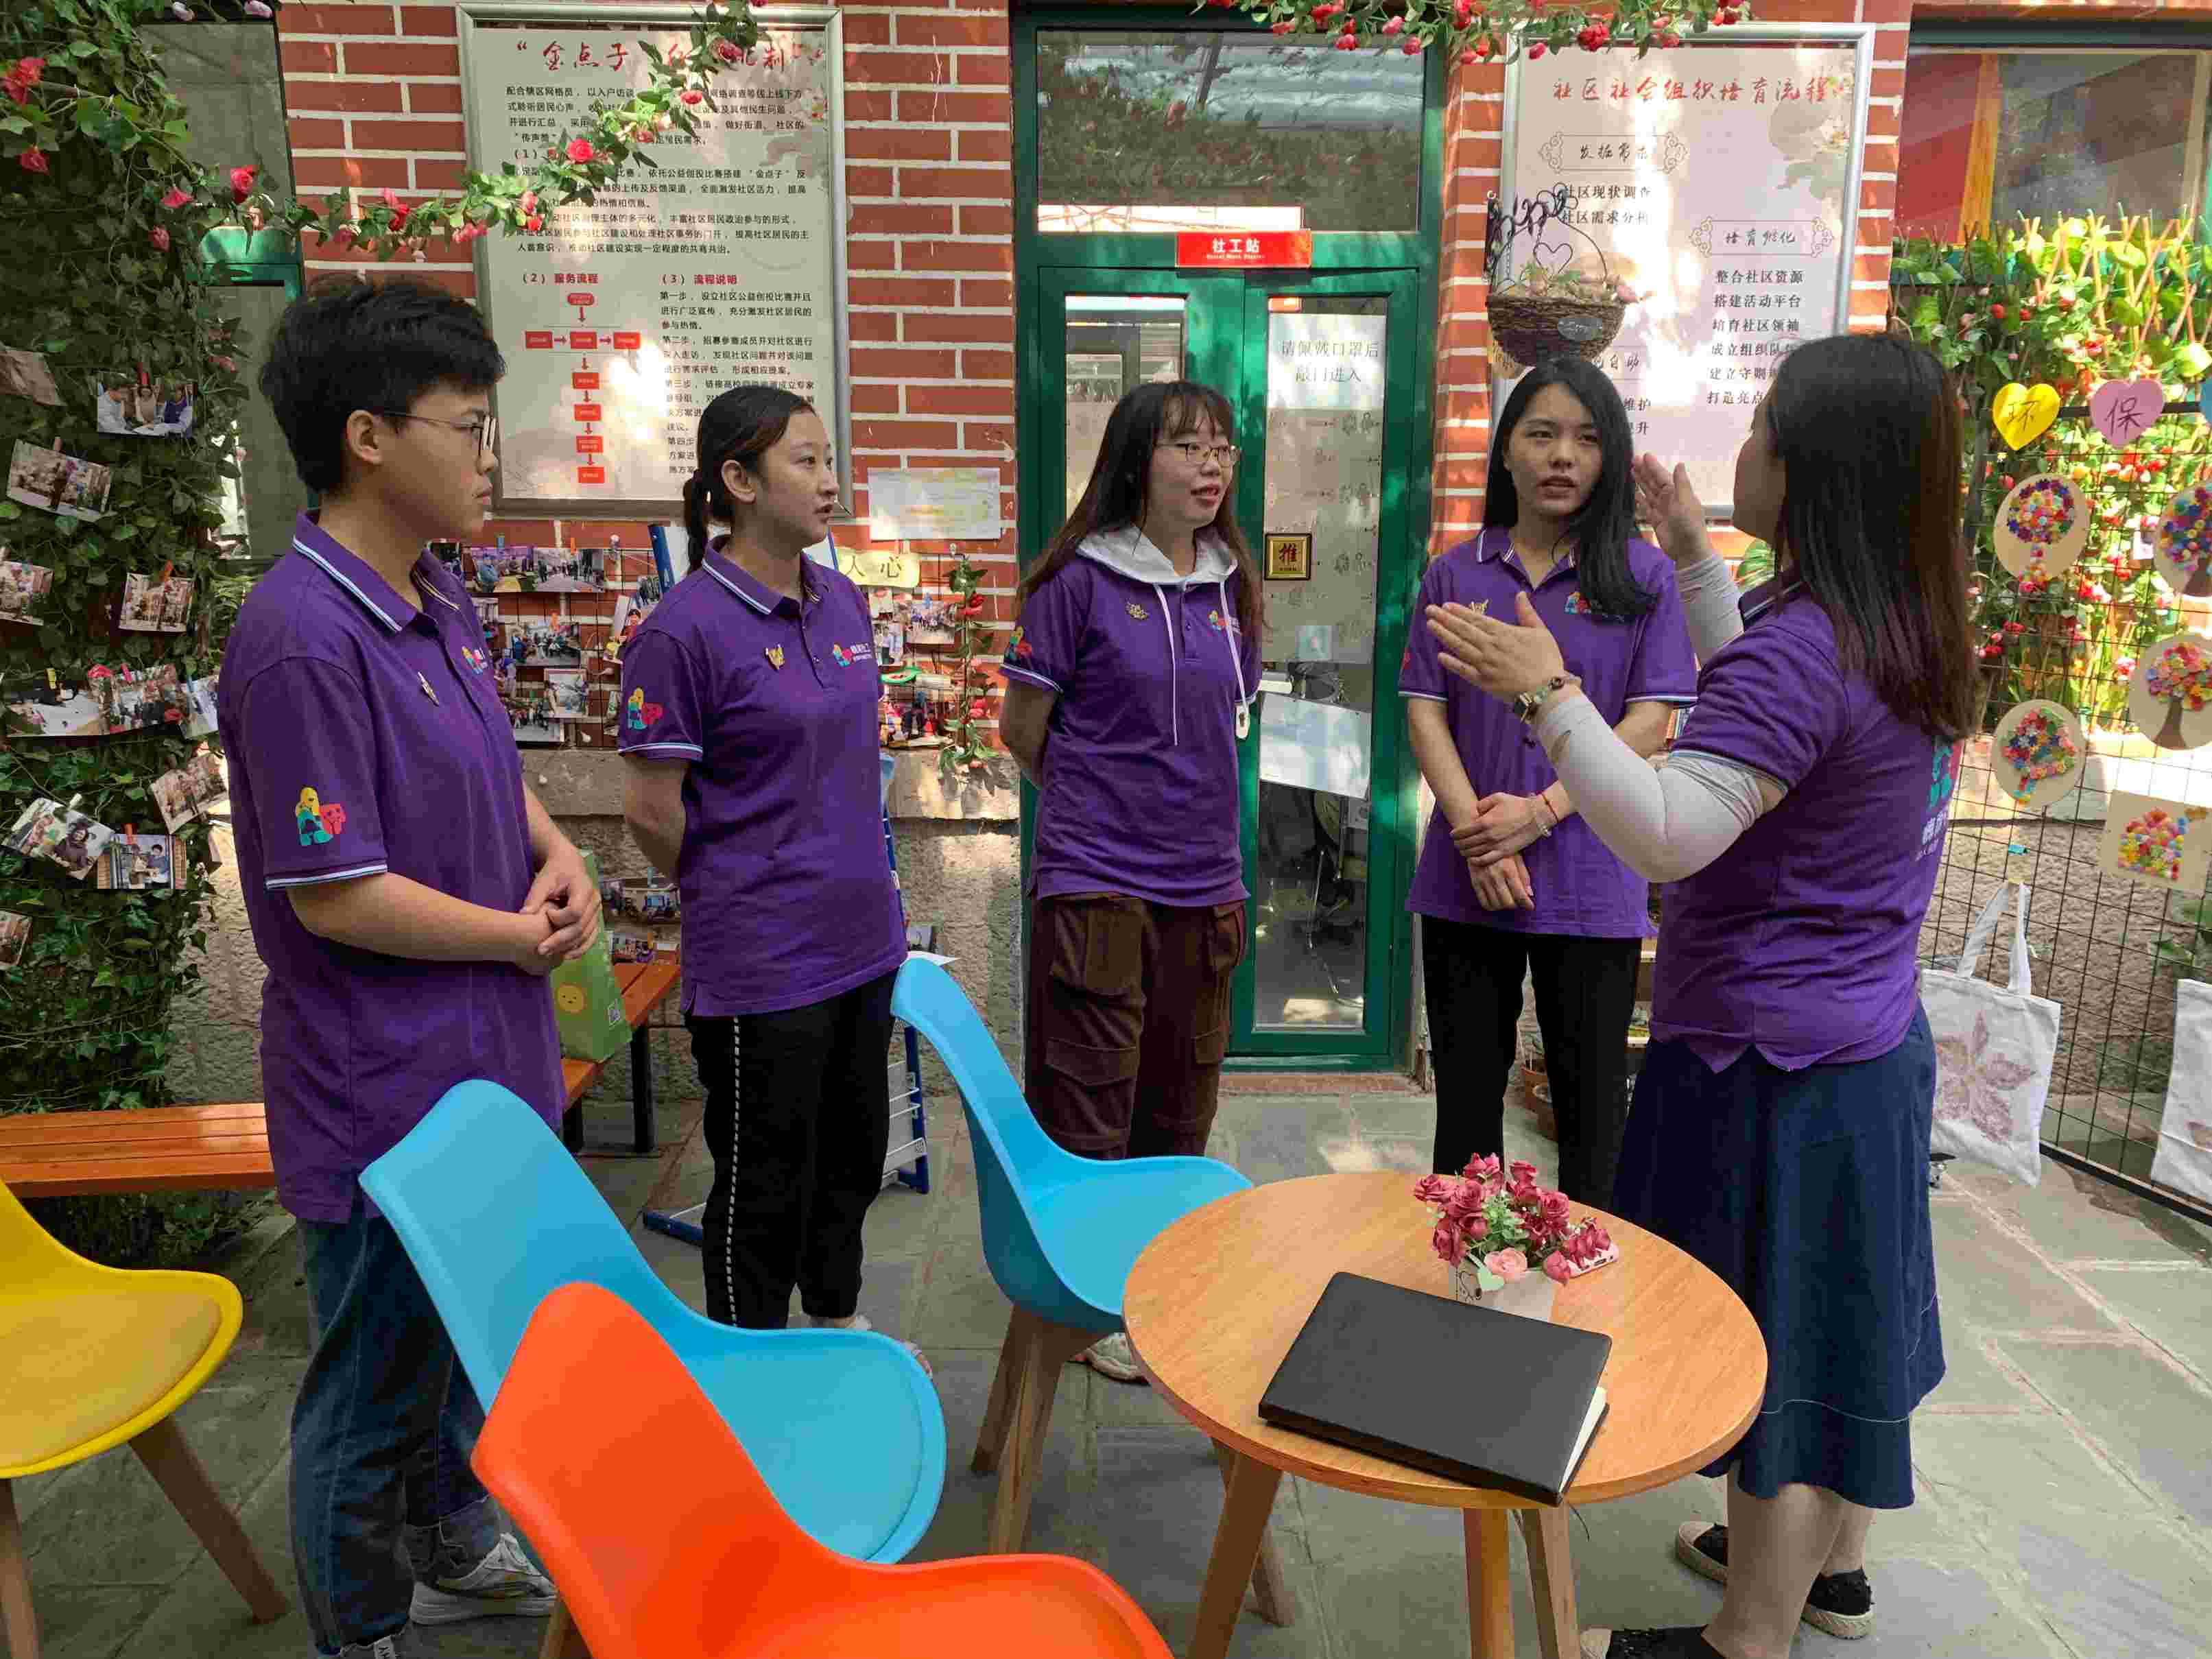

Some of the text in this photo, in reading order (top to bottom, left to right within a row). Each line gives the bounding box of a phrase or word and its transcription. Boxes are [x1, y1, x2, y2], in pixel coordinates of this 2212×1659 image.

[1552, 76, 1828, 104] 社区社会组织培育流程
[1213, 237, 1261, 253] 社工站
[1716, 270, 1804, 284] 整合社区资源
[1715, 294, 1801, 308] 搭建活动平台
[2104, 396, 2145, 438] 保
[1278, 542, 1297, 562] 推
